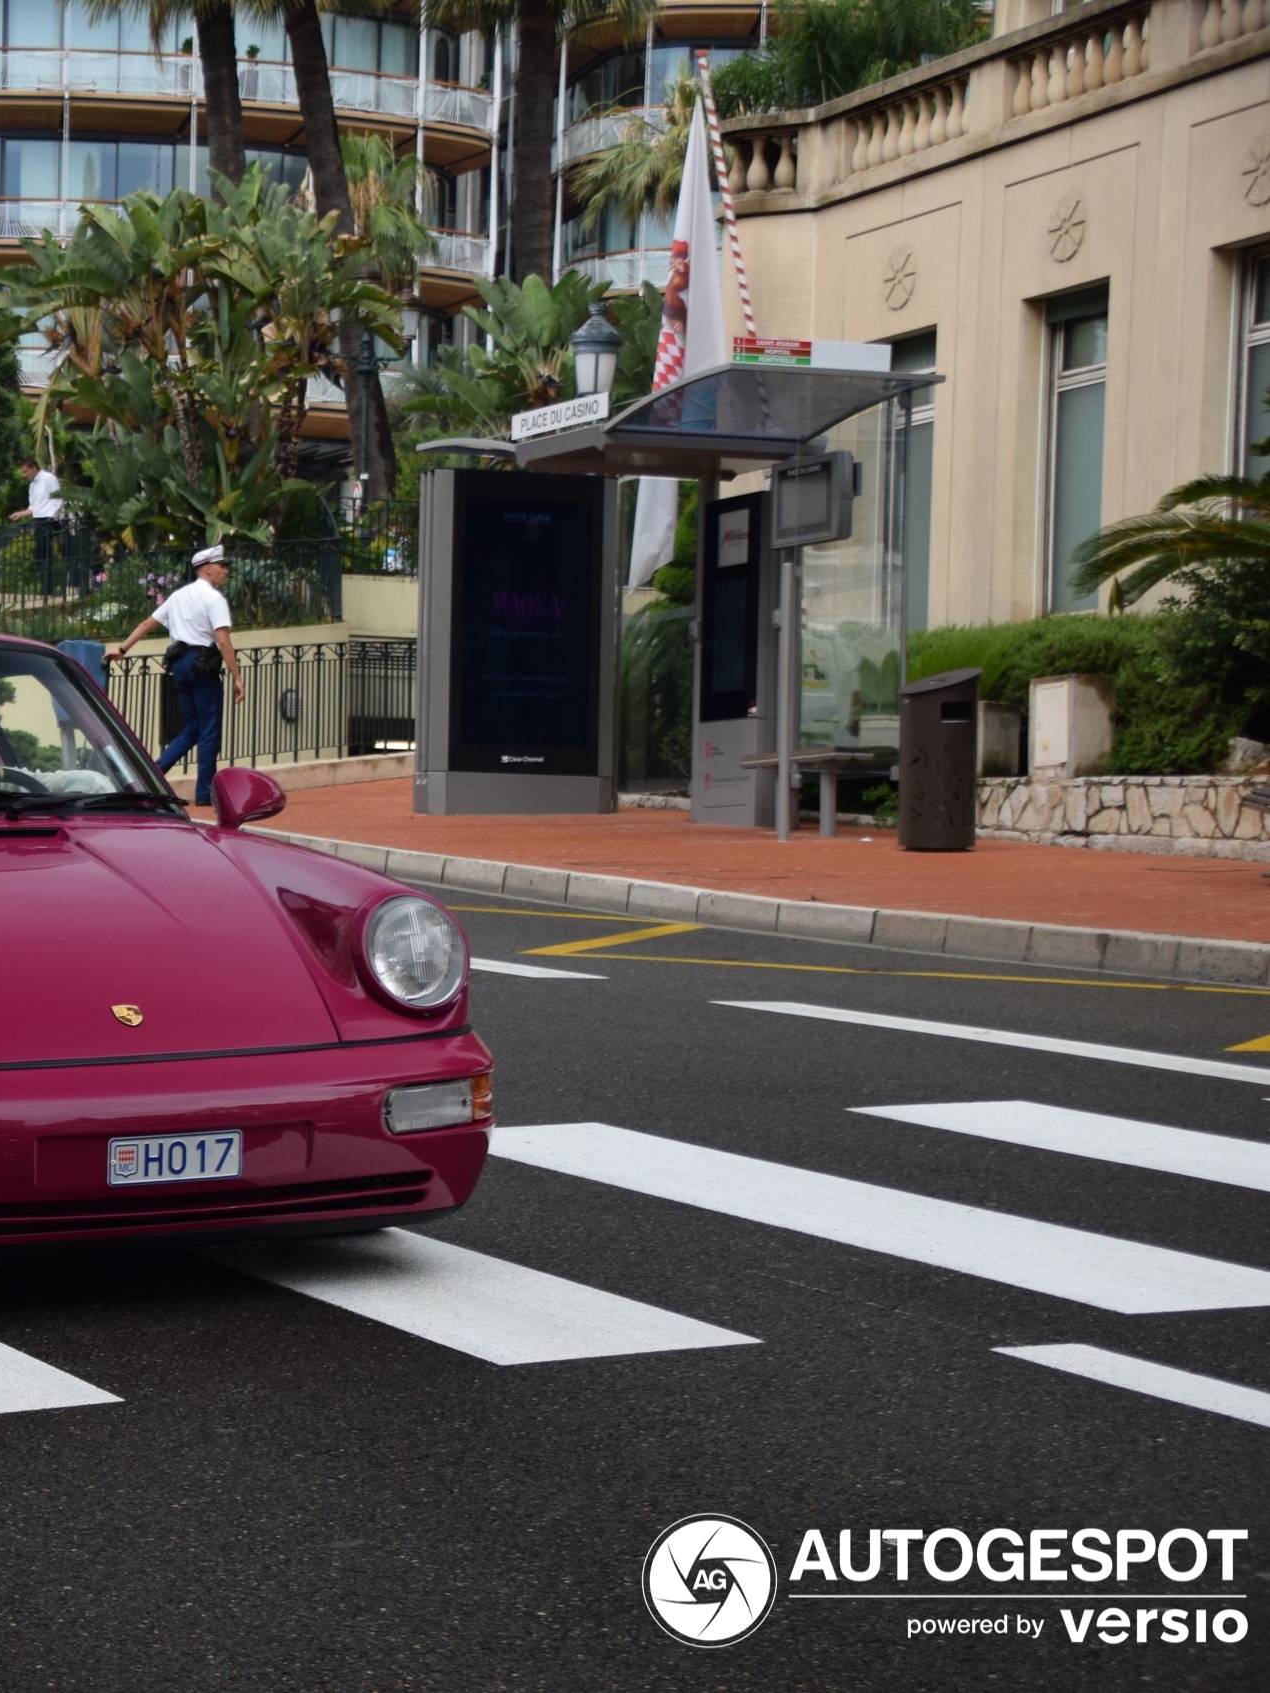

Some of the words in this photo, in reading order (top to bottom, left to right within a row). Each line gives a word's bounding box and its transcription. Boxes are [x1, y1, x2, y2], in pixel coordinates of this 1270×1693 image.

[755, 339, 800, 348] SAINT-ROMAN
[520, 413, 548, 433] PLACE
[549, 409, 563, 425] DU
[564, 400, 599, 421] CASINO
[118, 1162, 134, 1173] MC
